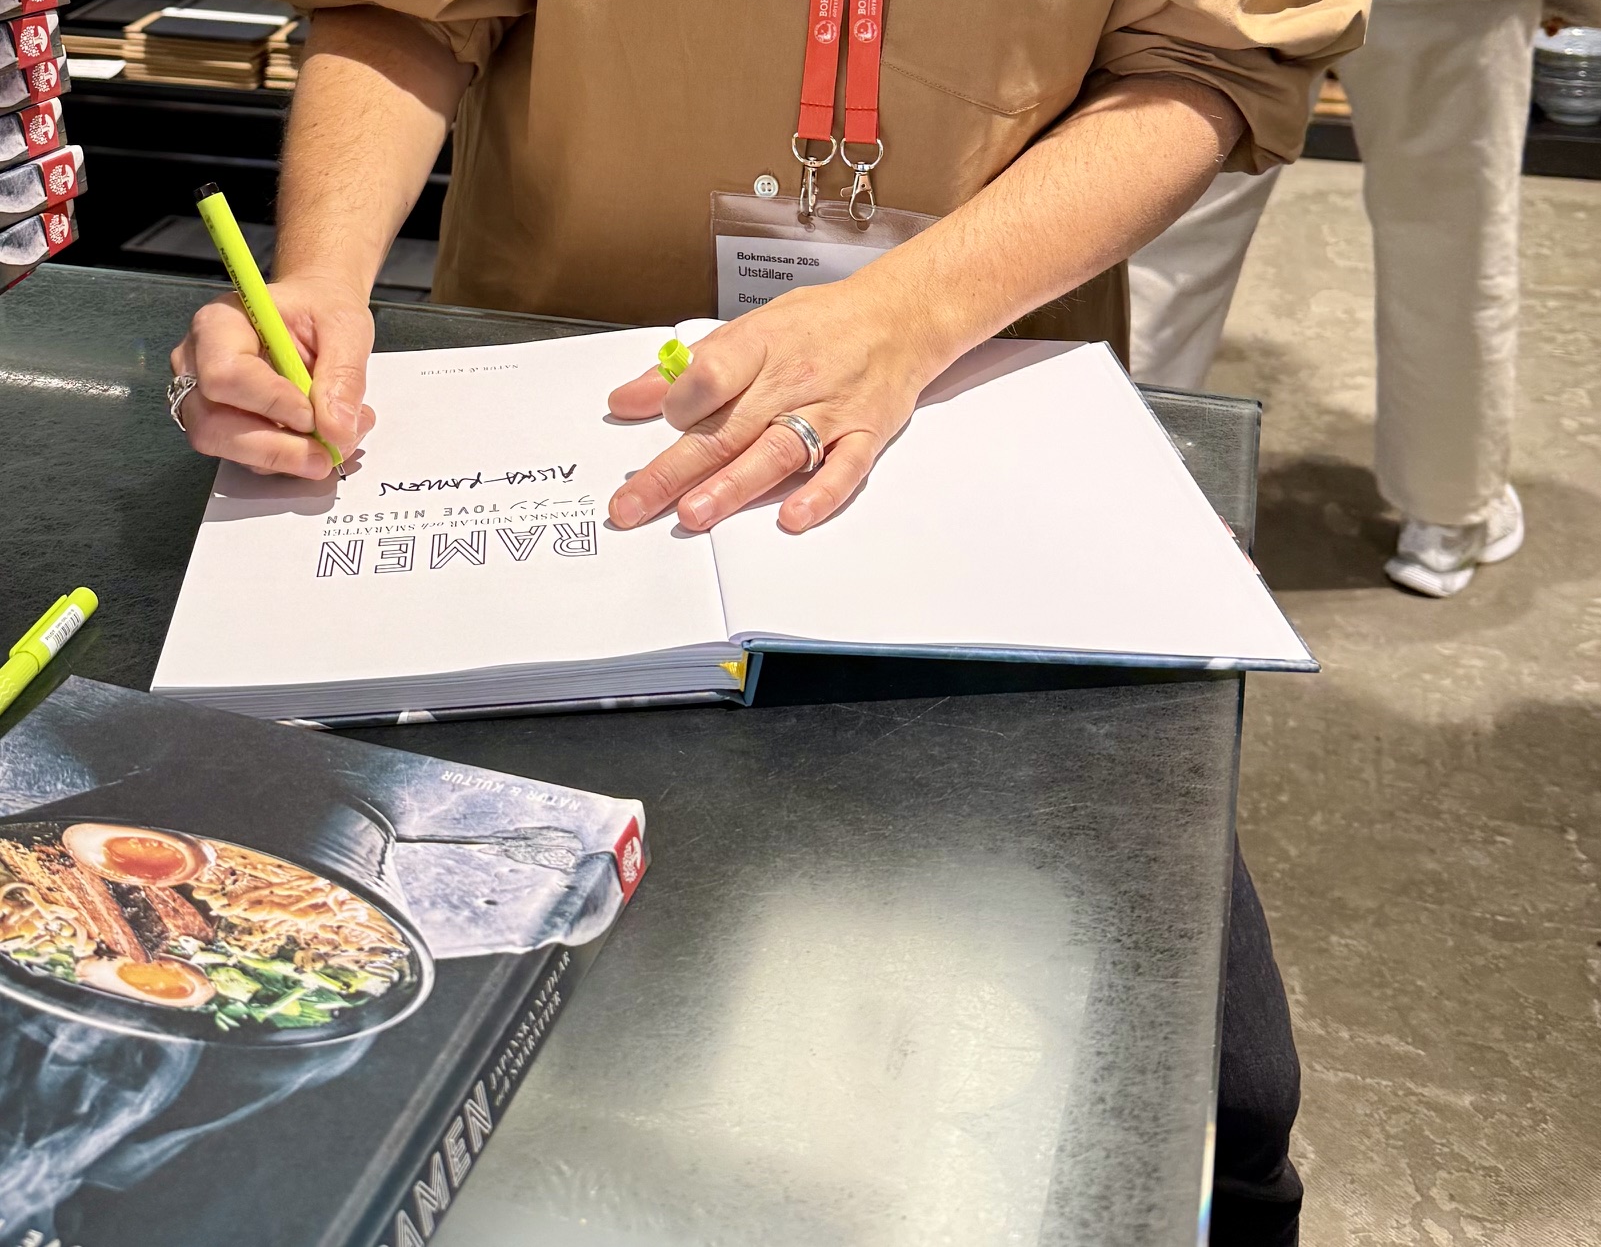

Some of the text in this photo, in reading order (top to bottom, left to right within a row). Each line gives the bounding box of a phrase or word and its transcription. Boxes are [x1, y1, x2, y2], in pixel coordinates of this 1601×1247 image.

[736, 252, 820, 267] Bokmässan 2026
[219, 247, 258, 325] LETTERING PEN
[738, 266, 794, 281] Utställare
[420, 368, 464, 376] KULTUR
[483, 364, 519, 372] NATUR
[326, 503, 500, 525] TOVE NILSSON
[510, 494, 595, 510] ラーメン
[323, 508, 596, 536] JAPANSKA NUDLAR och SMÅRÄTTER
[316, 521, 598, 578] RAMEN
[441, 770, 582, 811] NATUR & KULTUR
[489, 1010, 536, 1091] JAPANSKA
[378, 1079, 493, 1247] AMEN
